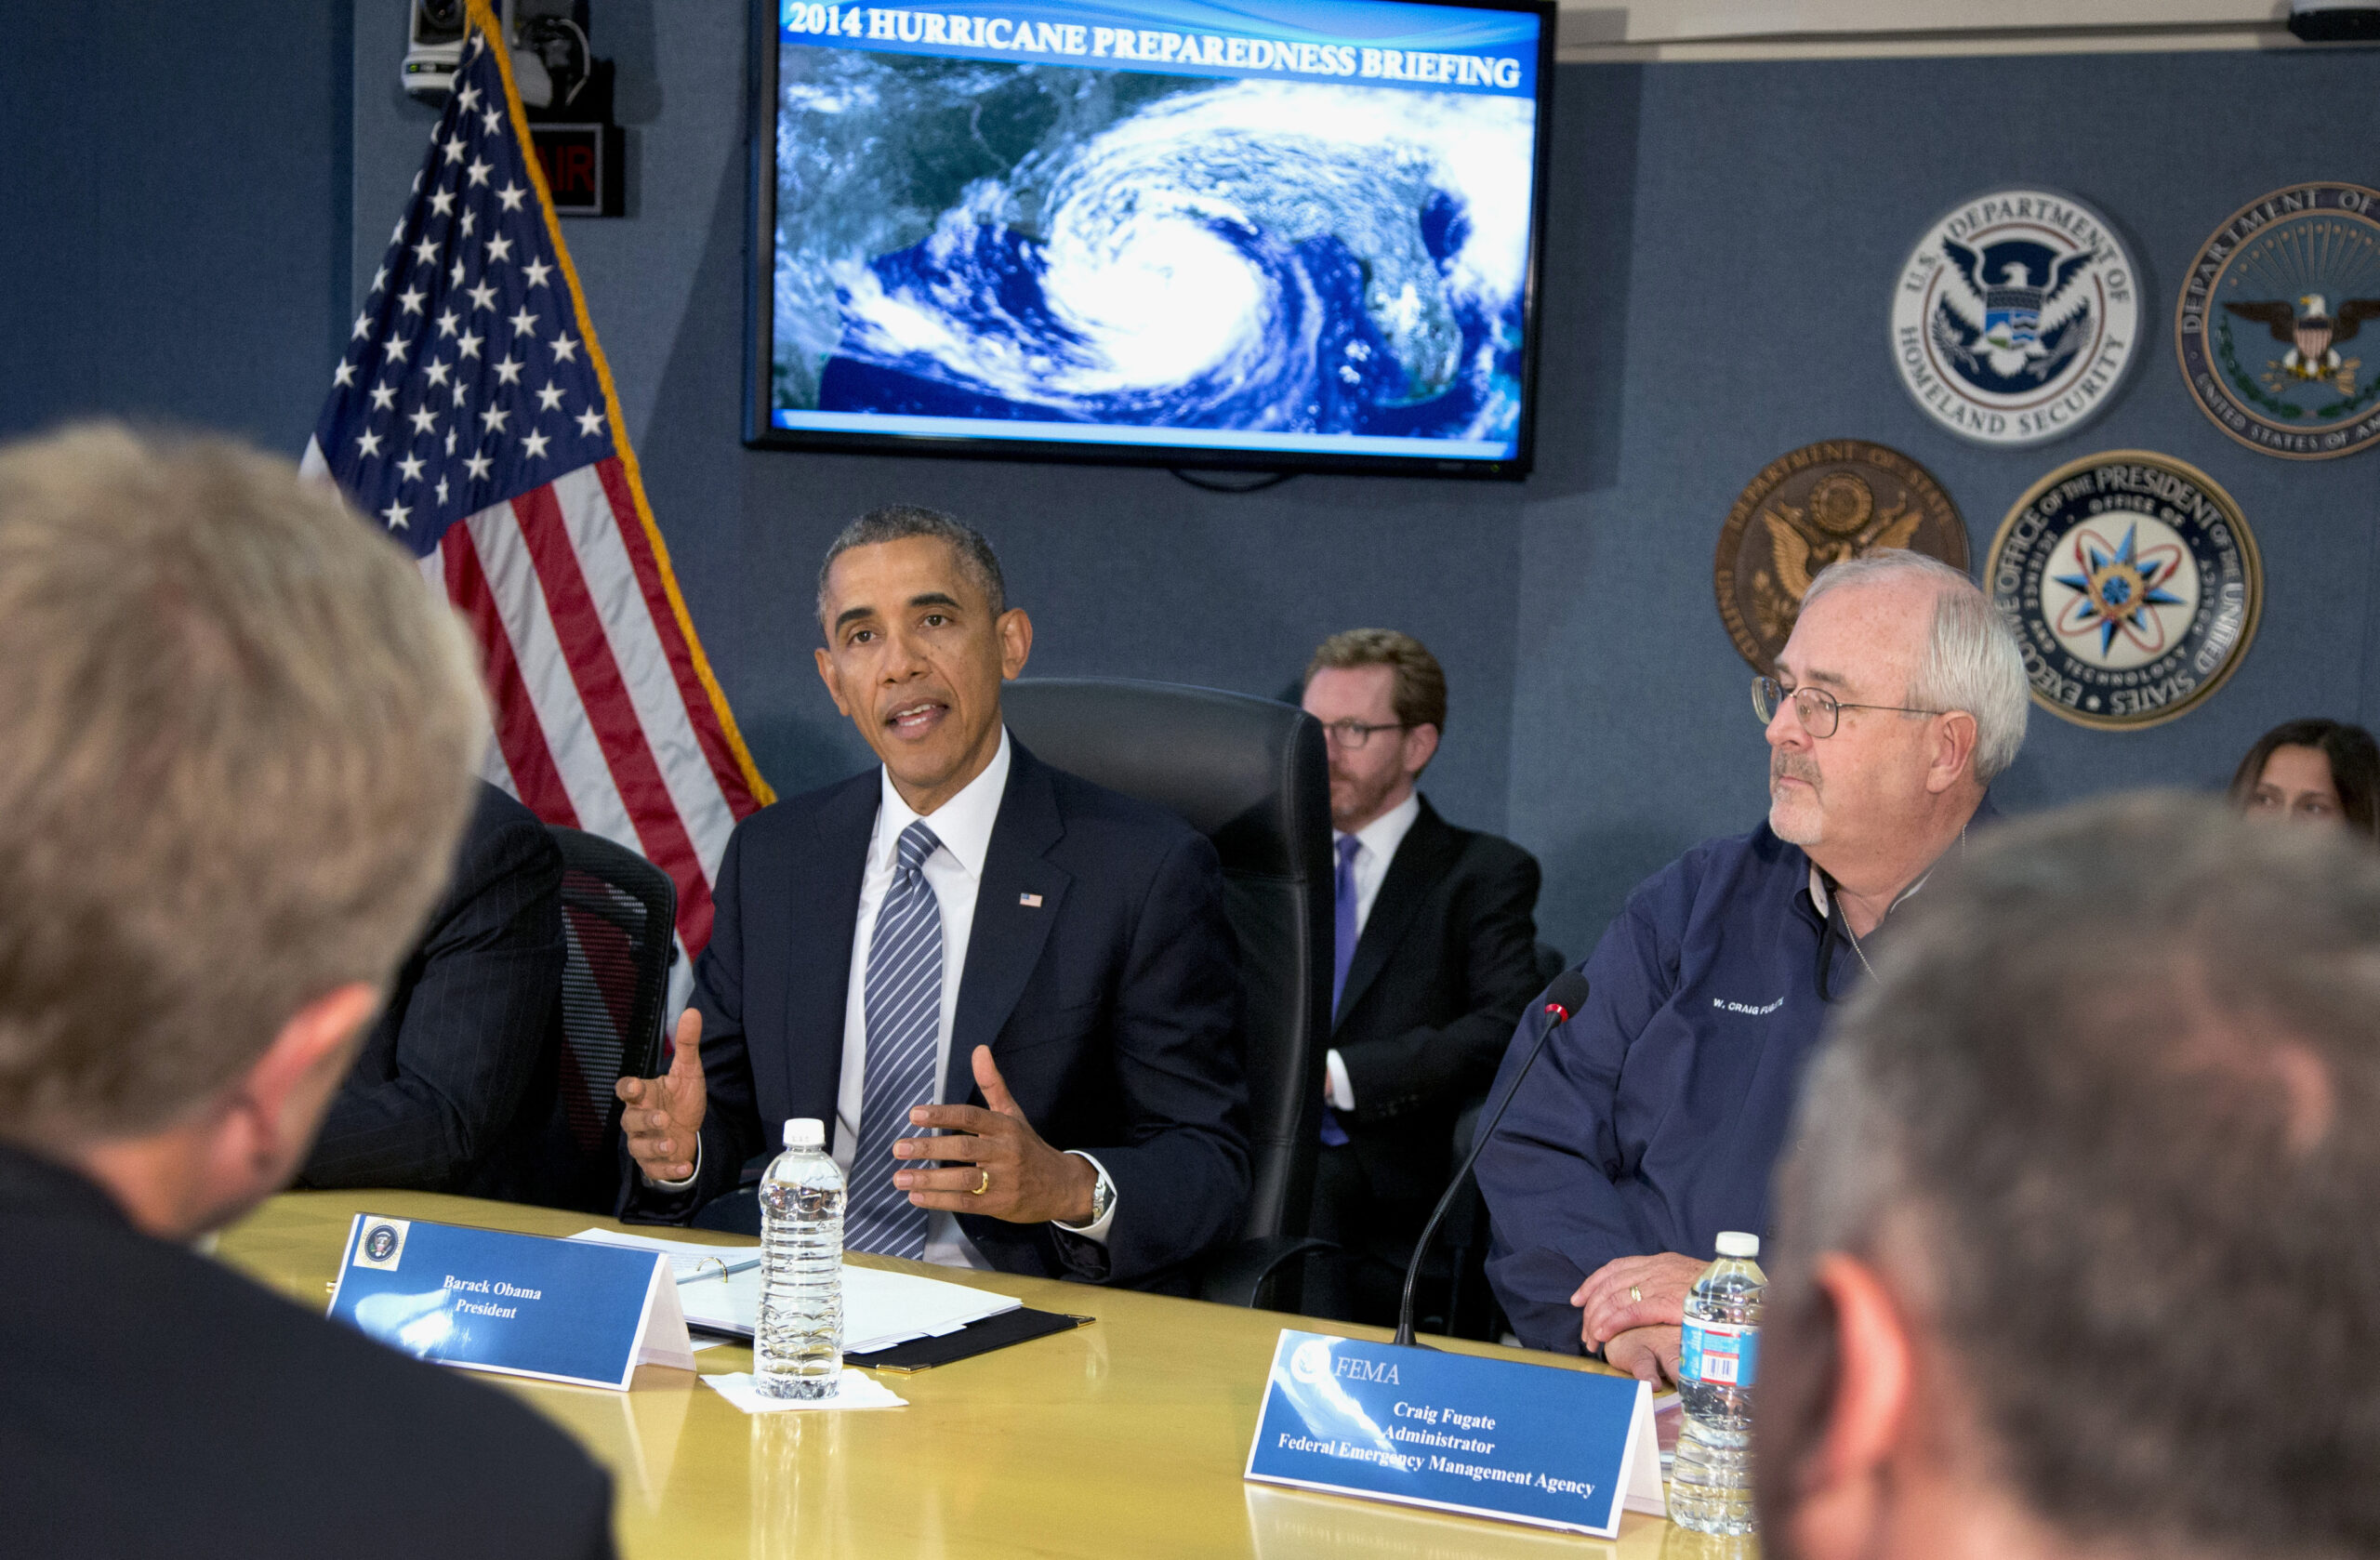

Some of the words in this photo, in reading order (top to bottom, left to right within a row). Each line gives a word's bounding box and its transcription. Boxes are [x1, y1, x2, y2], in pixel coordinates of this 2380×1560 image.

[787, 2, 863, 38] 2014
[867, 8, 1087, 55] HURRICANE
[1091, 30, 1357, 77] PREPAREDNESS
[1361, 48, 1521, 89] BRIEFING
[1950, 196, 2118, 264] DEPARTMENT
[2106, 269, 2130, 302] OF
[2183, 190, 2316, 334] DEPARTMENT
[1900, 326, 2006, 434] HOMELAND
[2019, 334, 2124, 434] SECURITY
[2251, 424, 2318, 452] STATES
[2040, 488, 2063, 516] OF
[2095, 465, 2223, 530] PRESIDENT
[1995, 507, 2048, 594] OFFICE
[2194, 582, 2243, 675] UNITED
[2109, 669, 2195, 715] STATES
[1713, 998, 1726, 1010] W.
[1727, 1001, 1759, 1015] CRAIG
[443, 1276, 490, 1294] Barack
[494, 1281, 541, 1301] Obama
[456, 1299, 517, 1319] President
[1336, 1357, 1400, 1385] FEMA
[1394, 1401, 1438, 1431] Craig
[1442, 1408, 1496, 1431] Fugate
[1383, 1427, 1495, 1455] Administrator
[1278, 1433, 1334, 1456] Federal
[1339, 1441, 1425, 1471] Emergency
[1429, 1456, 1532, 1482] Management
[1535, 1474, 1595, 1498] Agency
